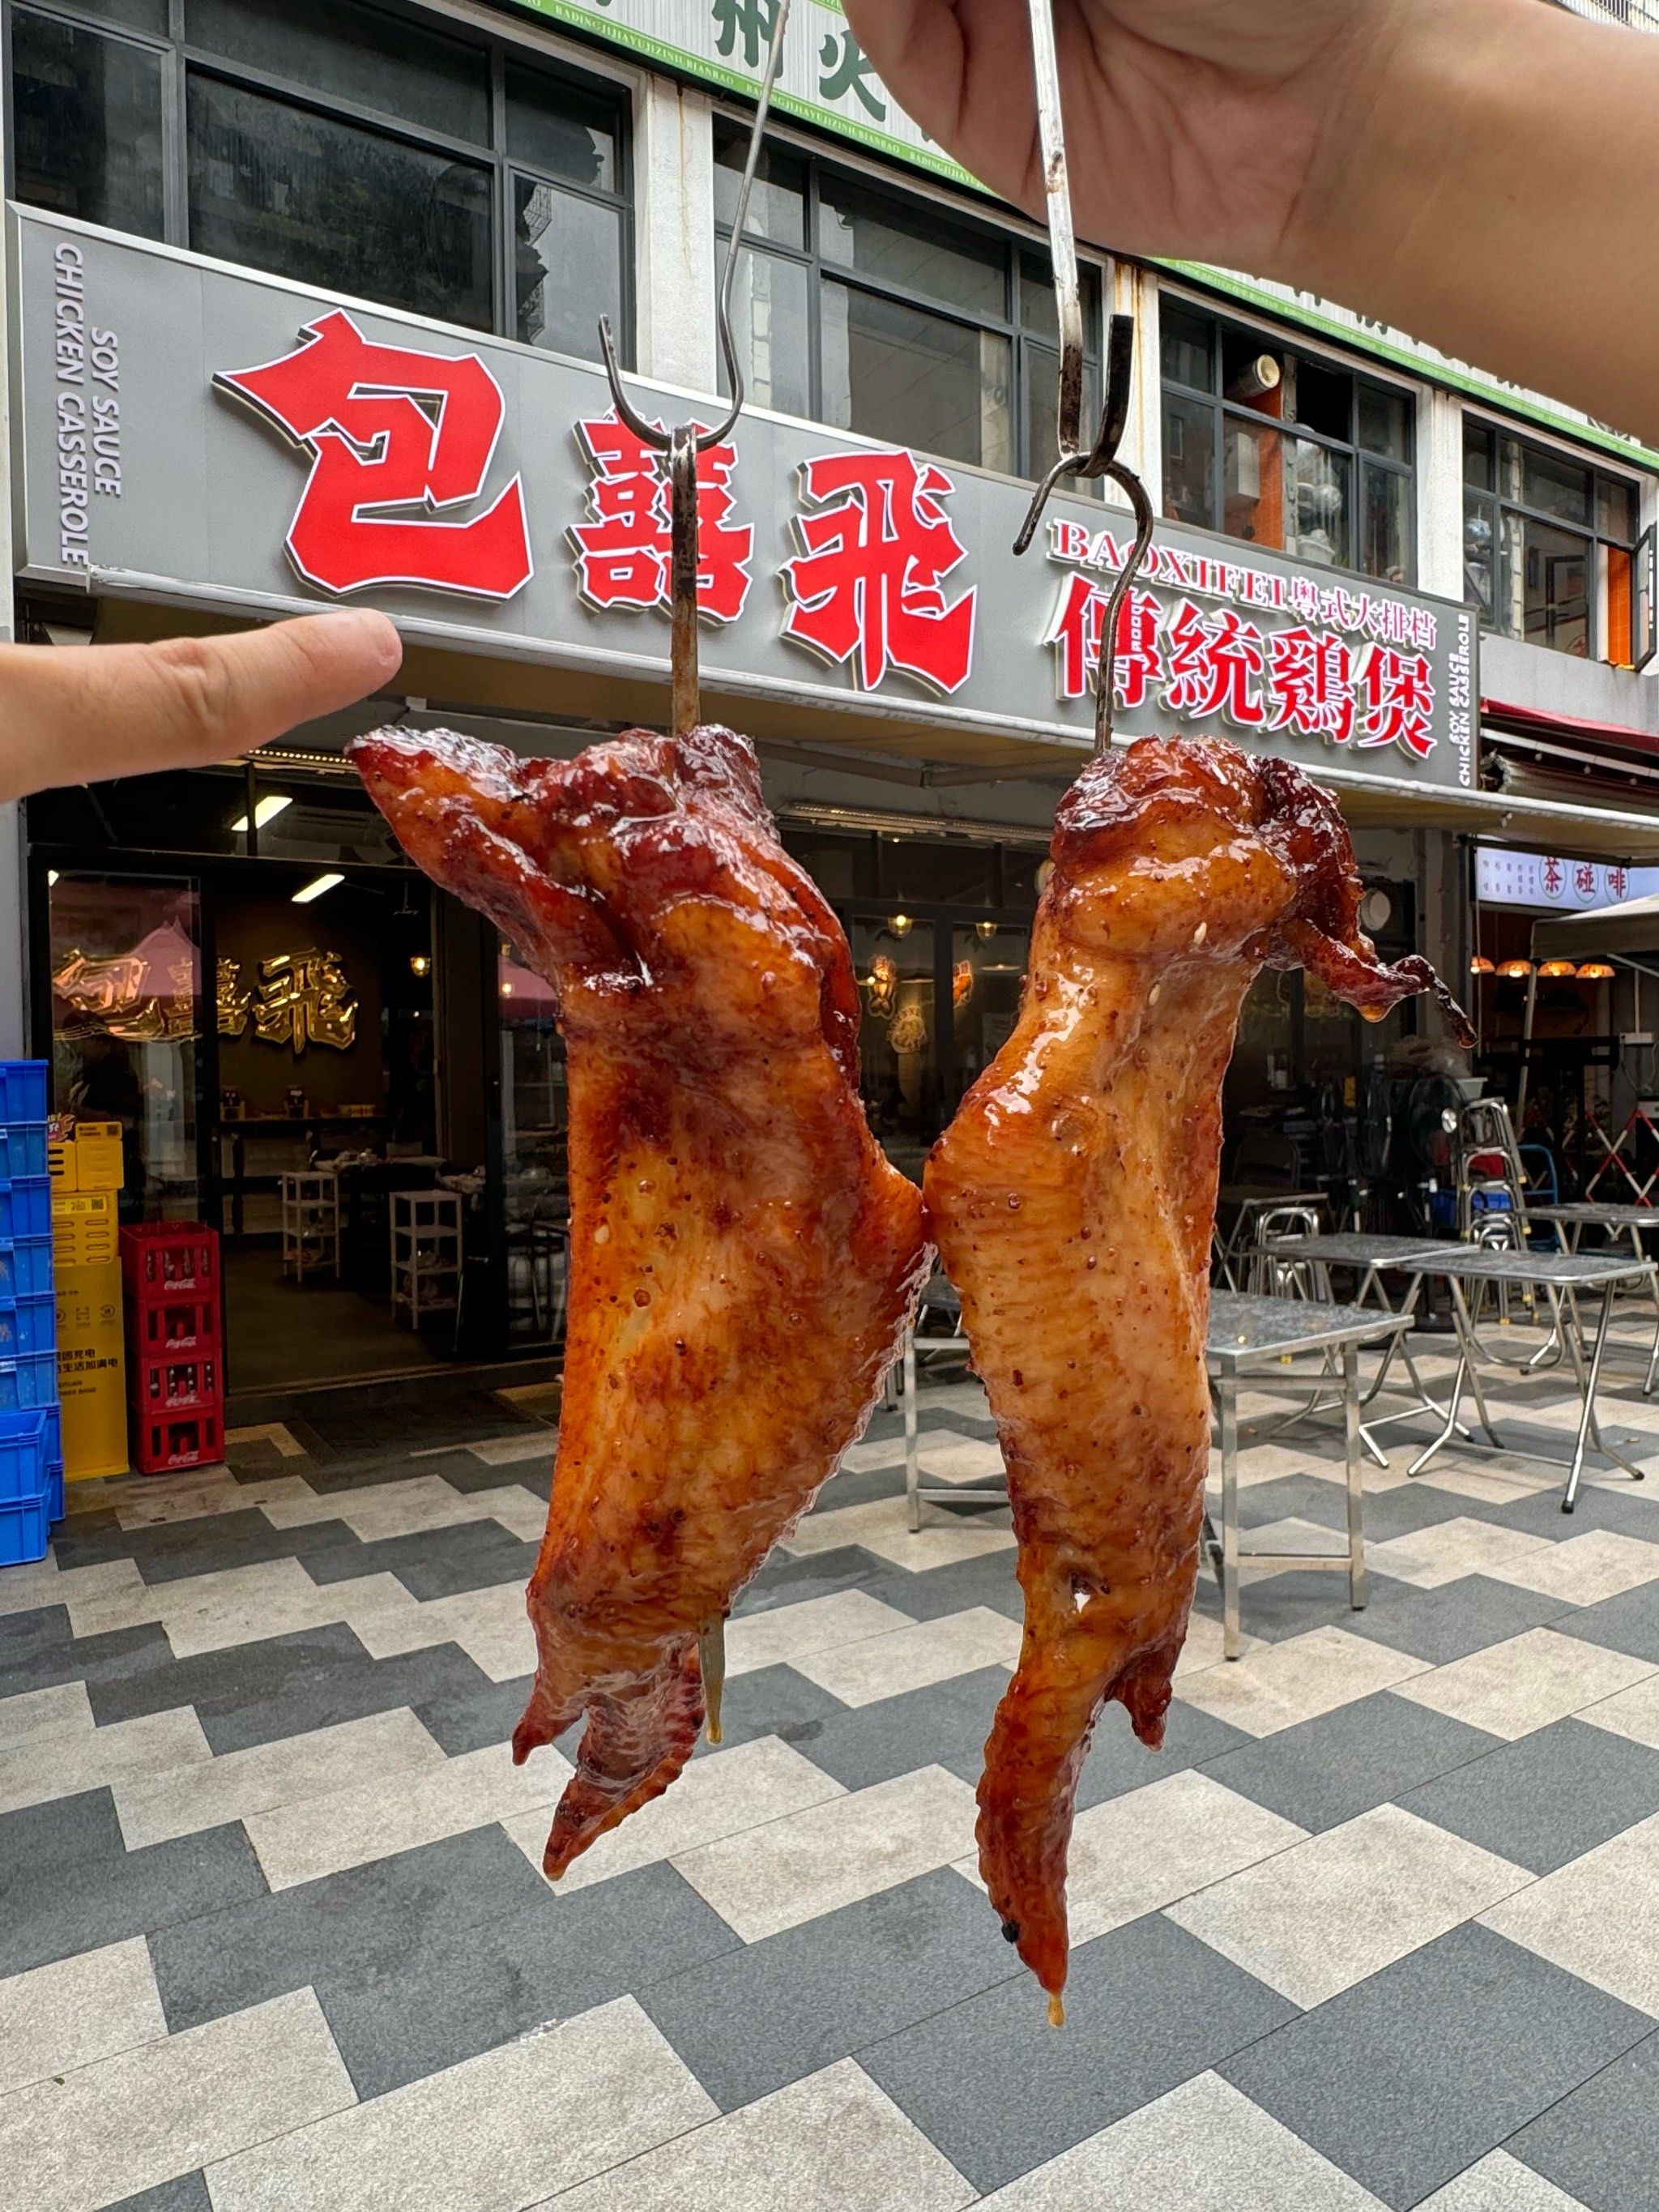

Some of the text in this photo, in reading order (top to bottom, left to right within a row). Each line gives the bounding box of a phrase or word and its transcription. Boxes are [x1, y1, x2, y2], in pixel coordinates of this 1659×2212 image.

[54, 242, 89, 566] CHICKEN CASSEROLE
[90, 327, 121, 496] SOY SAUCE
[1052, 519, 1287, 609] BAOXIFEI
[1448, 652, 1459, 745] SOY SAUCE
[1458, 613, 1470, 787] CHICKEN CASSEROLE
